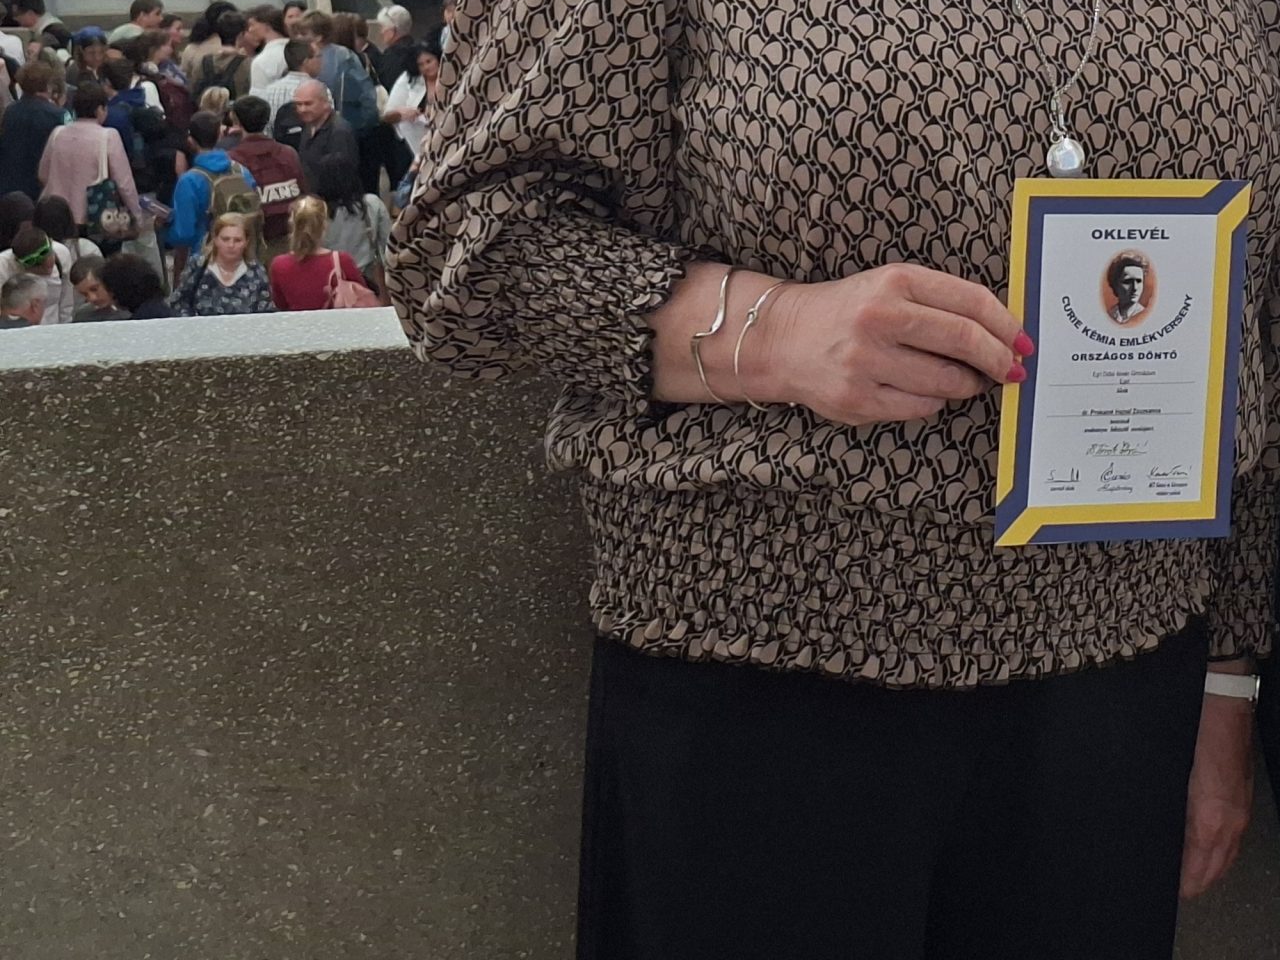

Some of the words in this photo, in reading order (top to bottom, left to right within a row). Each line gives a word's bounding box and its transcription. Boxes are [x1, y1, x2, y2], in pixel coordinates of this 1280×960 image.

[256, 179, 300, 203] VANS
[1091, 227, 1170, 240] OKLEVÉL
[1061, 295, 1083, 330] CURIE
[1081, 325, 1116, 347] KÉMIA
[1119, 293, 1193, 347] EMLÉKVERSENY
[1071, 350, 1134, 362] ORSZÁGOS
[1137, 349, 1178, 361] DÖNTŐ
